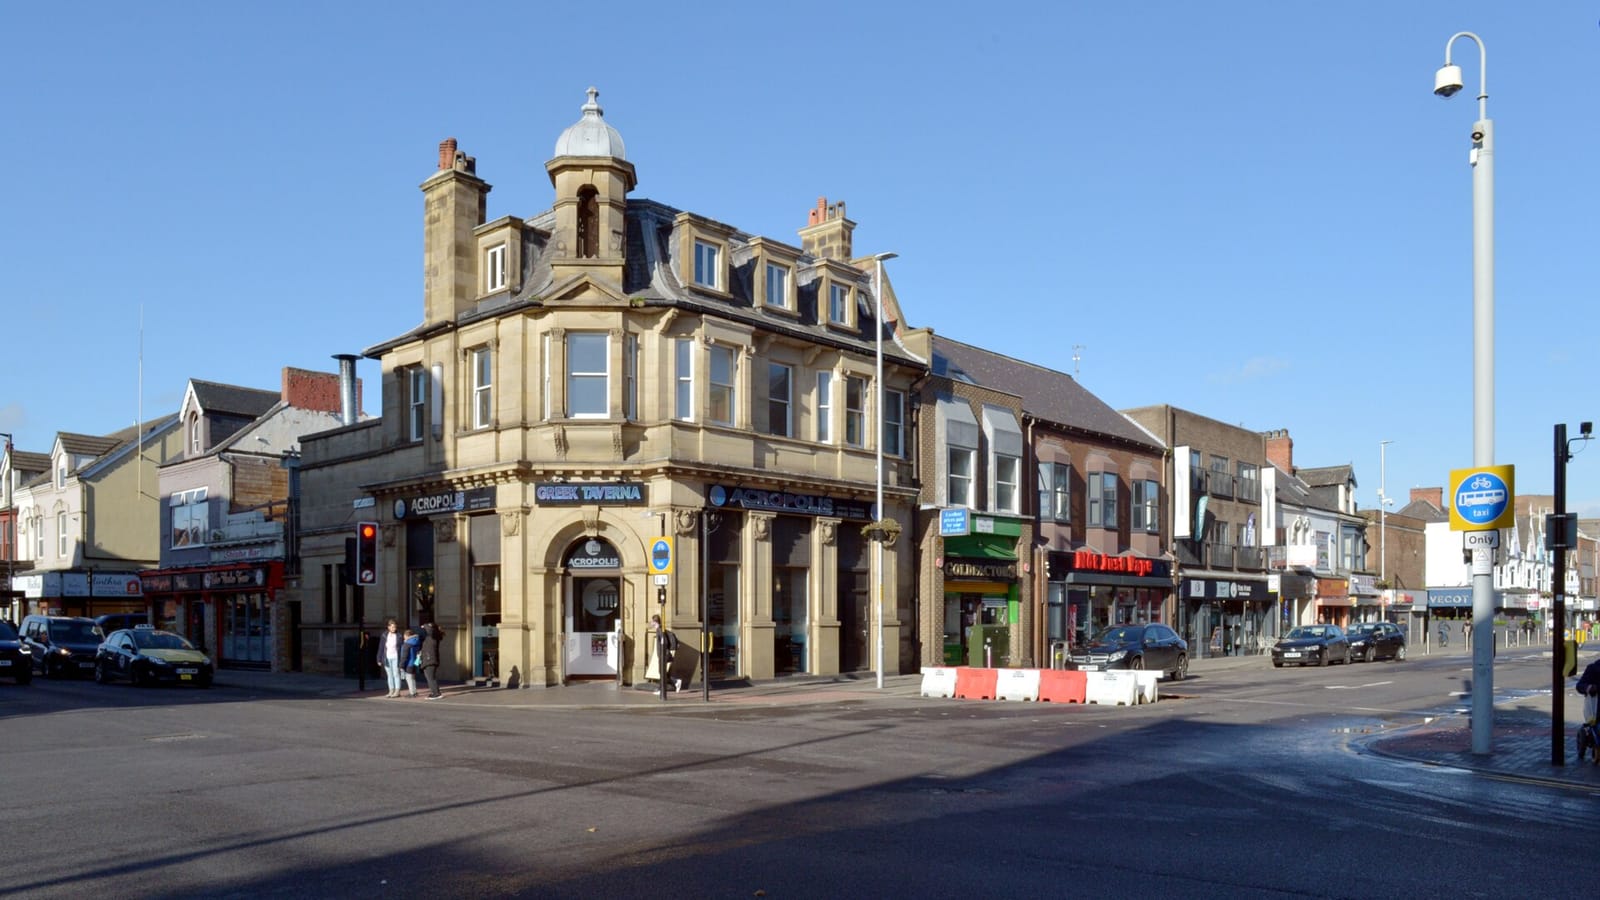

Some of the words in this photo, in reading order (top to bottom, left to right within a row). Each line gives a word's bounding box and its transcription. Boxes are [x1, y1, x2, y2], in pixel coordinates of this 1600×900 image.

[536, 486, 579, 500] GREEK
[581, 486, 641, 500] TAVERNA
[729, 488, 833, 515] ACROPOLIS
[1473, 508, 1489, 517] taxi
[1469, 535, 1494, 545] Only
[568, 557, 619, 567] ACROPOLIS
[1075, 550, 1098, 569] Not
[1100, 553, 1125, 571] Just
[1127, 556, 1152, 576] Vape
